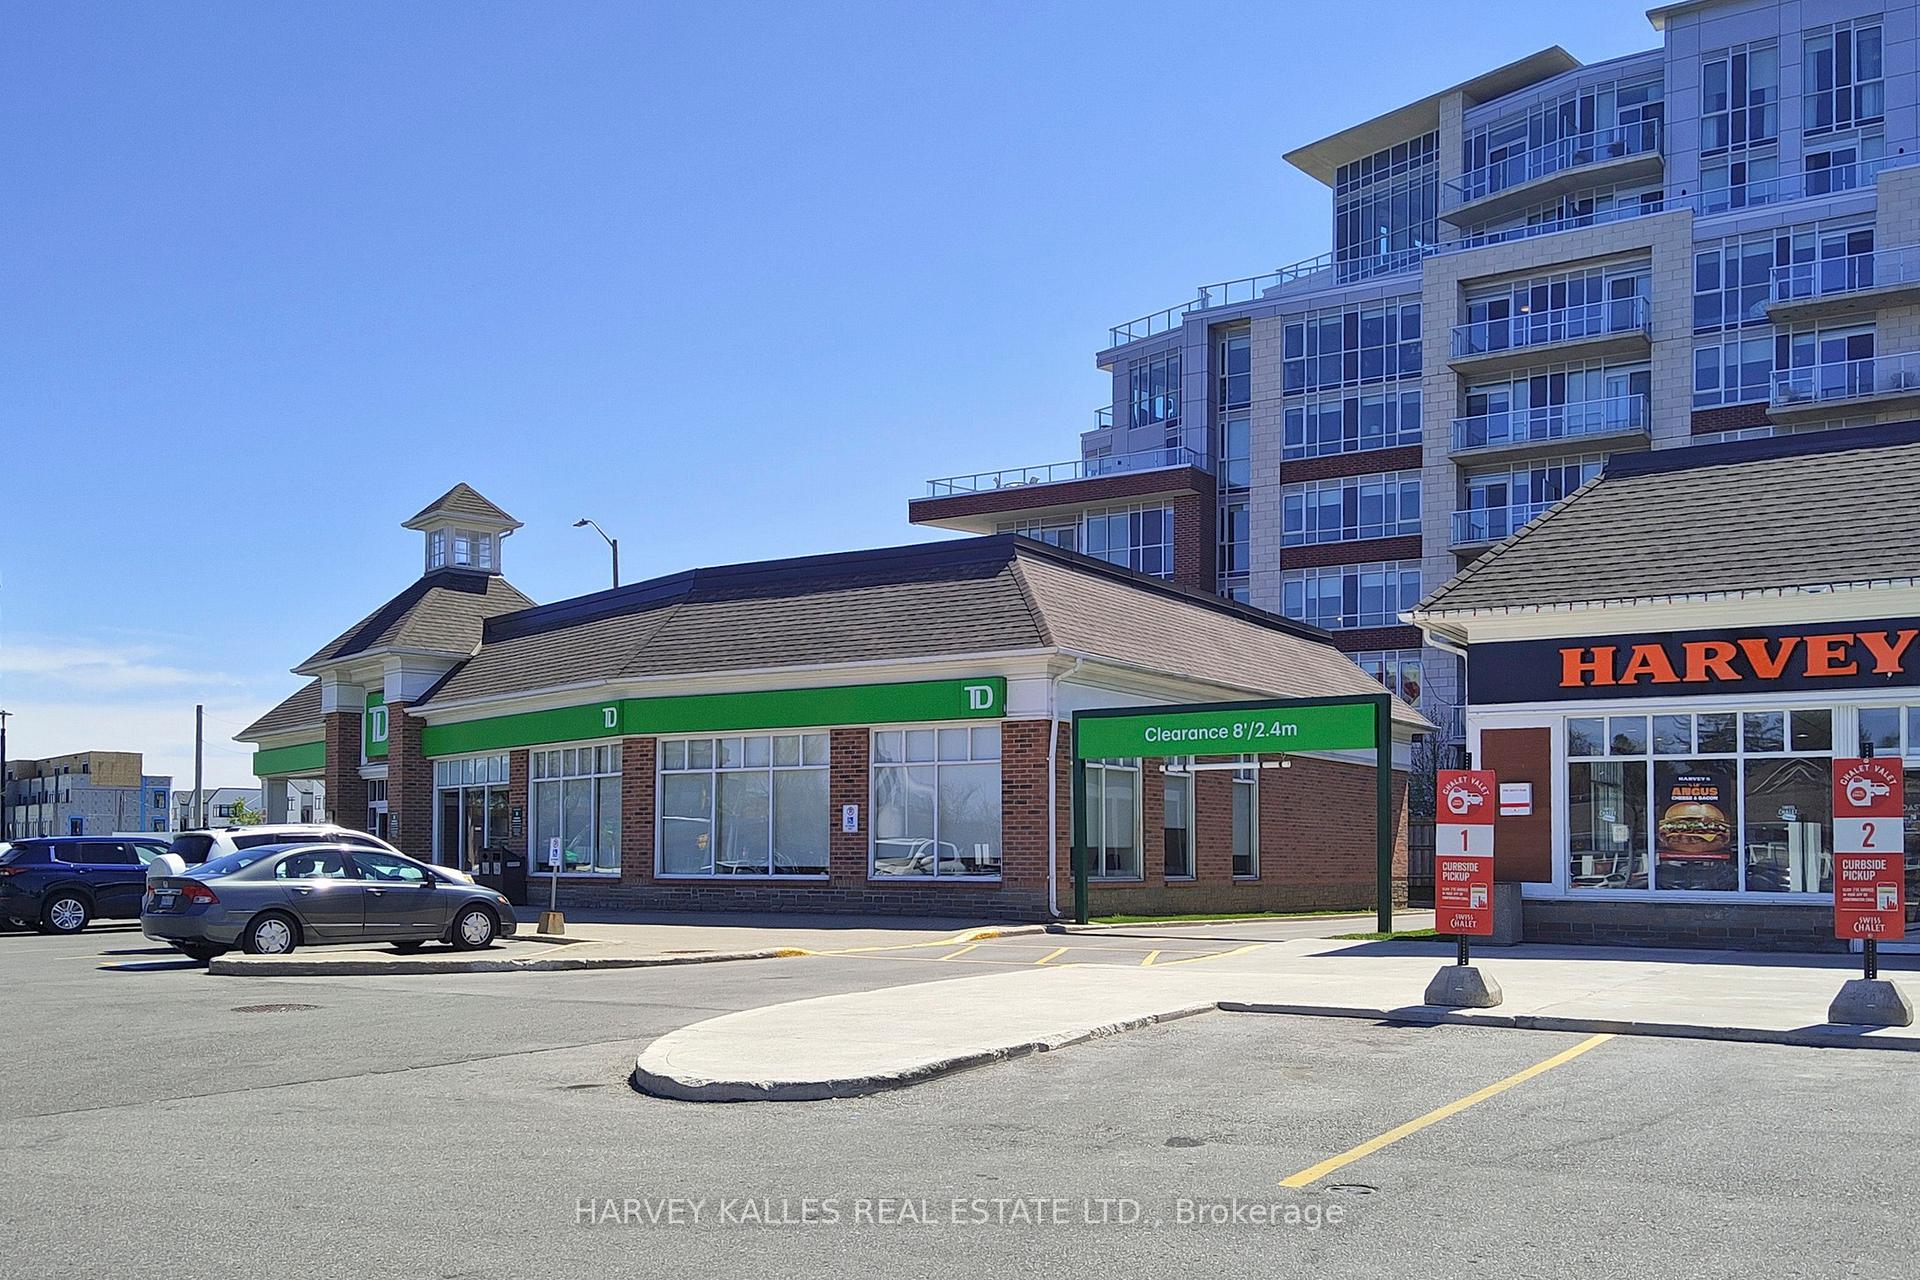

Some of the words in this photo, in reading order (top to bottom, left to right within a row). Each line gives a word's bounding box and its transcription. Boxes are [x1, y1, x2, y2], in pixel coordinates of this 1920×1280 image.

[964, 685, 993, 710] TD
[602, 706, 617, 729] TD
[368, 705, 389, 743] TD
[1145, 727, 1229, 742] Clearance
[1232, 721, 1298, 741] 8'/2.4m
[1840, 764, 1870, 786] CHALET
[1874, 764, 1898, 785] VALET
[1442, 776, 1468, 795] CHALET
[1471, 776, 1490, 796] VALET
[1671, 787, 1718, 796] ANGUS
[1460, 829, 1468, 852] 1
[1862, 822, 1876, 848] 2
[1442, 861, 1479, 872] CURBSIDE
[1842, 859, 1887, 870] CURBSIDE
[1442, 871, 1470, 882] PICKUP
[1842, 870, 1876, 881] PICKUP
[1450, 918, 1477, 928] CHALET
[1455, 913, 1474, 921] SWISS
[1859, 916, 1881, 925] SWISS
[1853, 921, 1886, 933] CHALET
